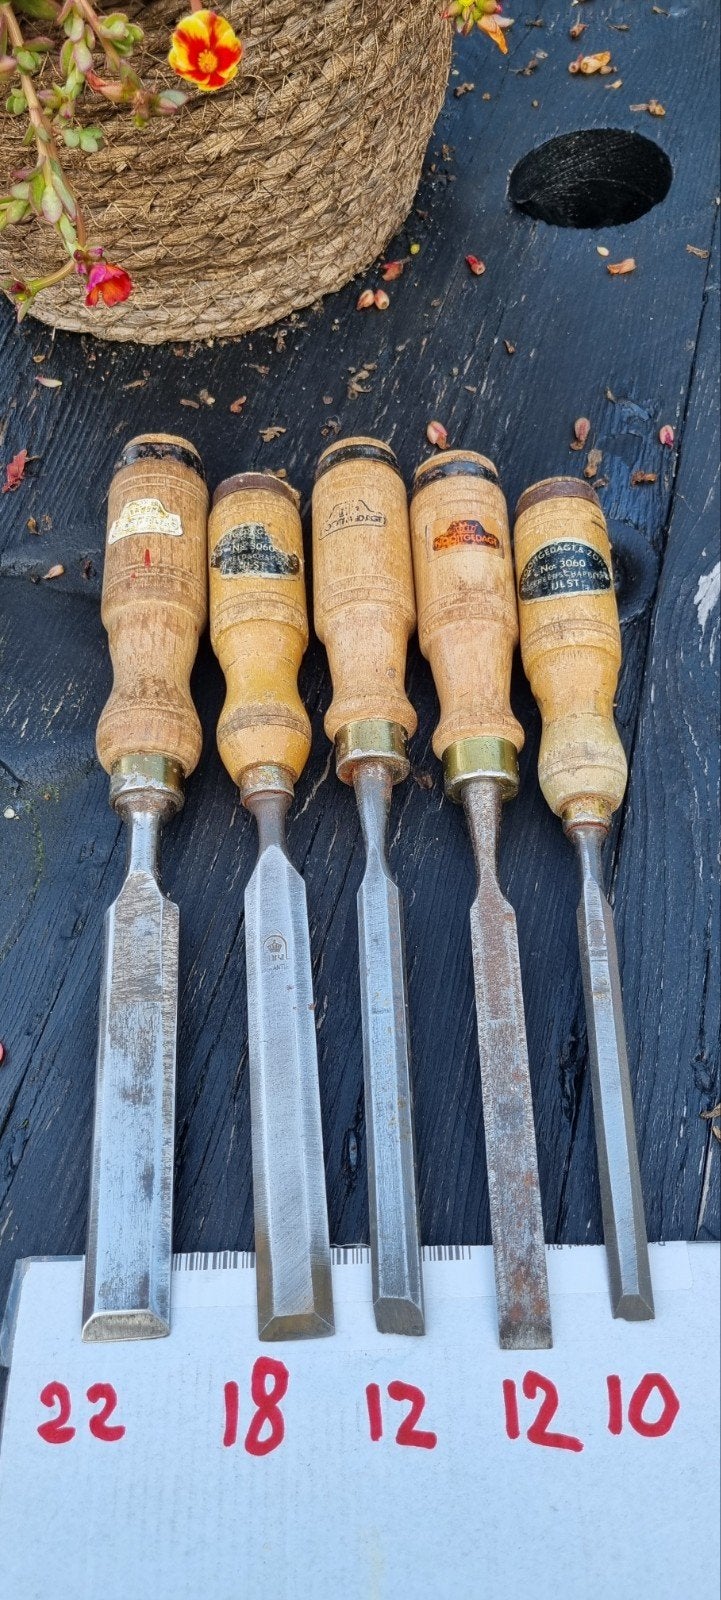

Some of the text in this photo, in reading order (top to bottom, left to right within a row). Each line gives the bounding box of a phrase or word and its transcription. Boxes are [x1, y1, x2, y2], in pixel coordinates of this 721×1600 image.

[559, 559, 586, 569] 3060
[38, 1382, 125, 1444] 22
[223, 1356, 289, 1456] 18
[366, 1381, 437, 1449] 12
[503, 1371, 583, 1452] 12
[607, 1374, 680, 1438] 10
